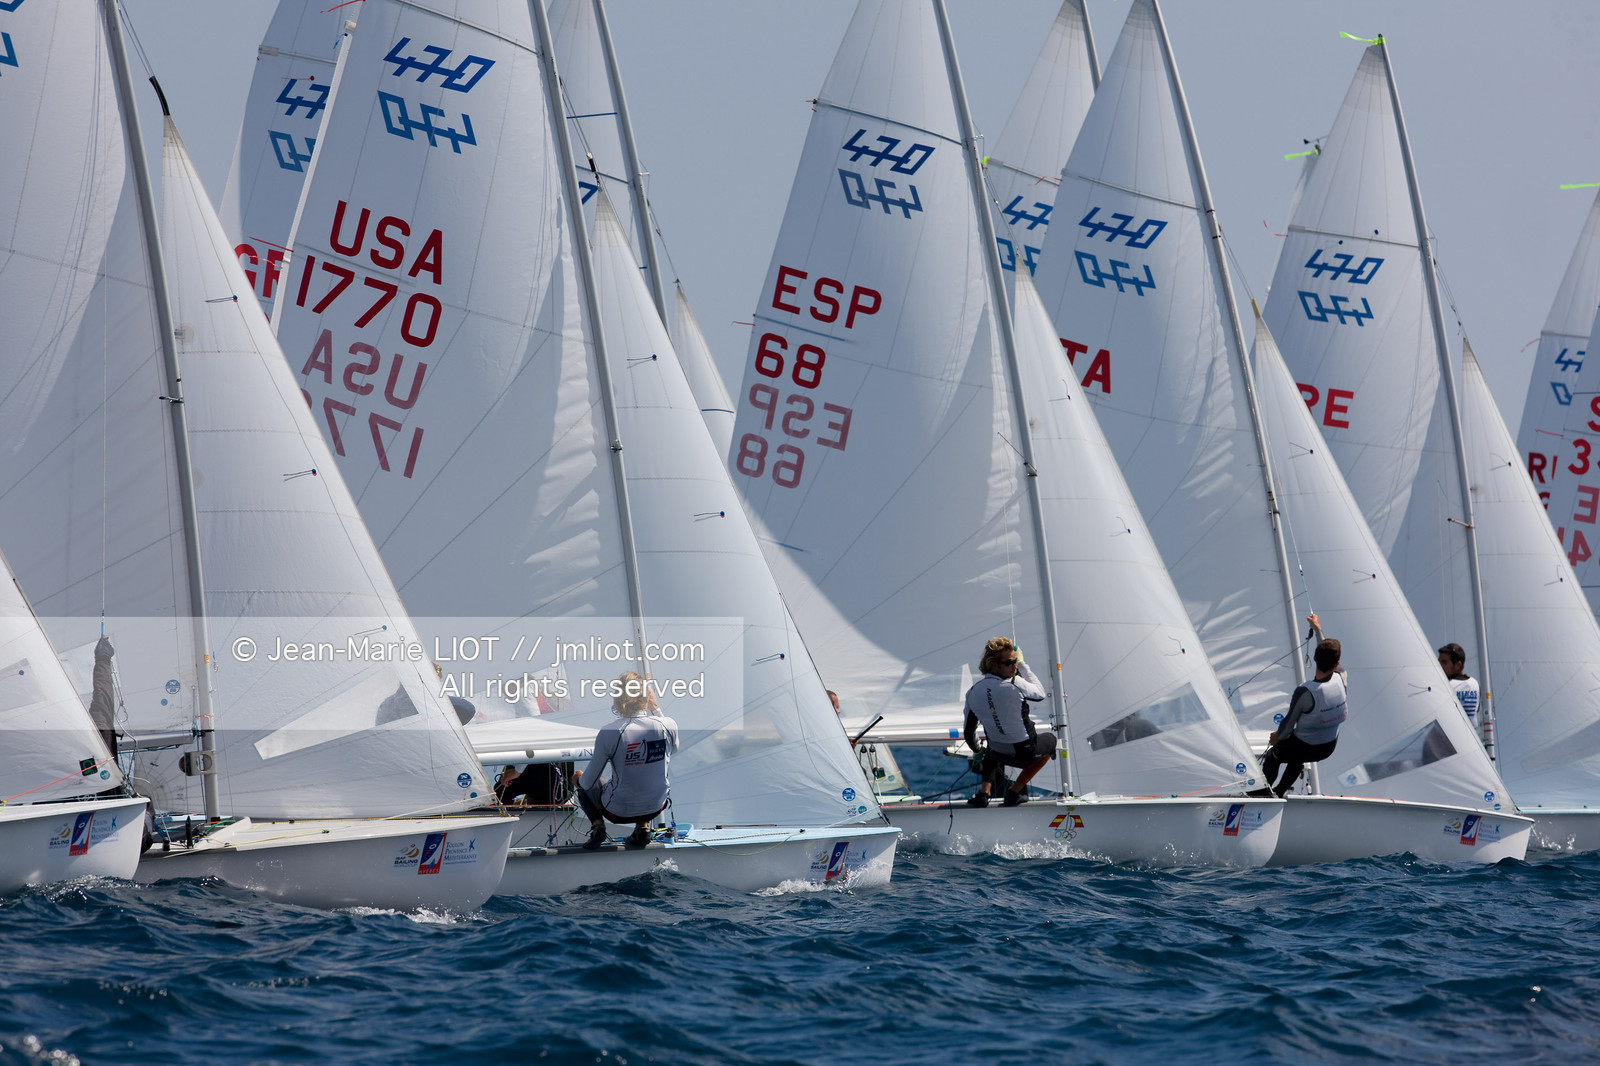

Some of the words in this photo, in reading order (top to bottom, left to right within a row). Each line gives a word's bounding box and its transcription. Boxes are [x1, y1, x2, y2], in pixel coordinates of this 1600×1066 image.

[382, 37, 496, 93] 470
[276, 78, 332, 119] 47
[842, 128, 936, 176] 470
[1002, 195, 1054, 230] 47
[1079, 207, 1168, 249] 470
[329, 200, 442, 285] USA
[1304, 249, 1385, 285] 470
[296, 255, 442, 347] 1770
[771, 265, 882, 329] ESP
[754, 333, 826, 390] 68
[1059, 337, 1111, 394] TA
[1296, 383, 1354, 429] RE
